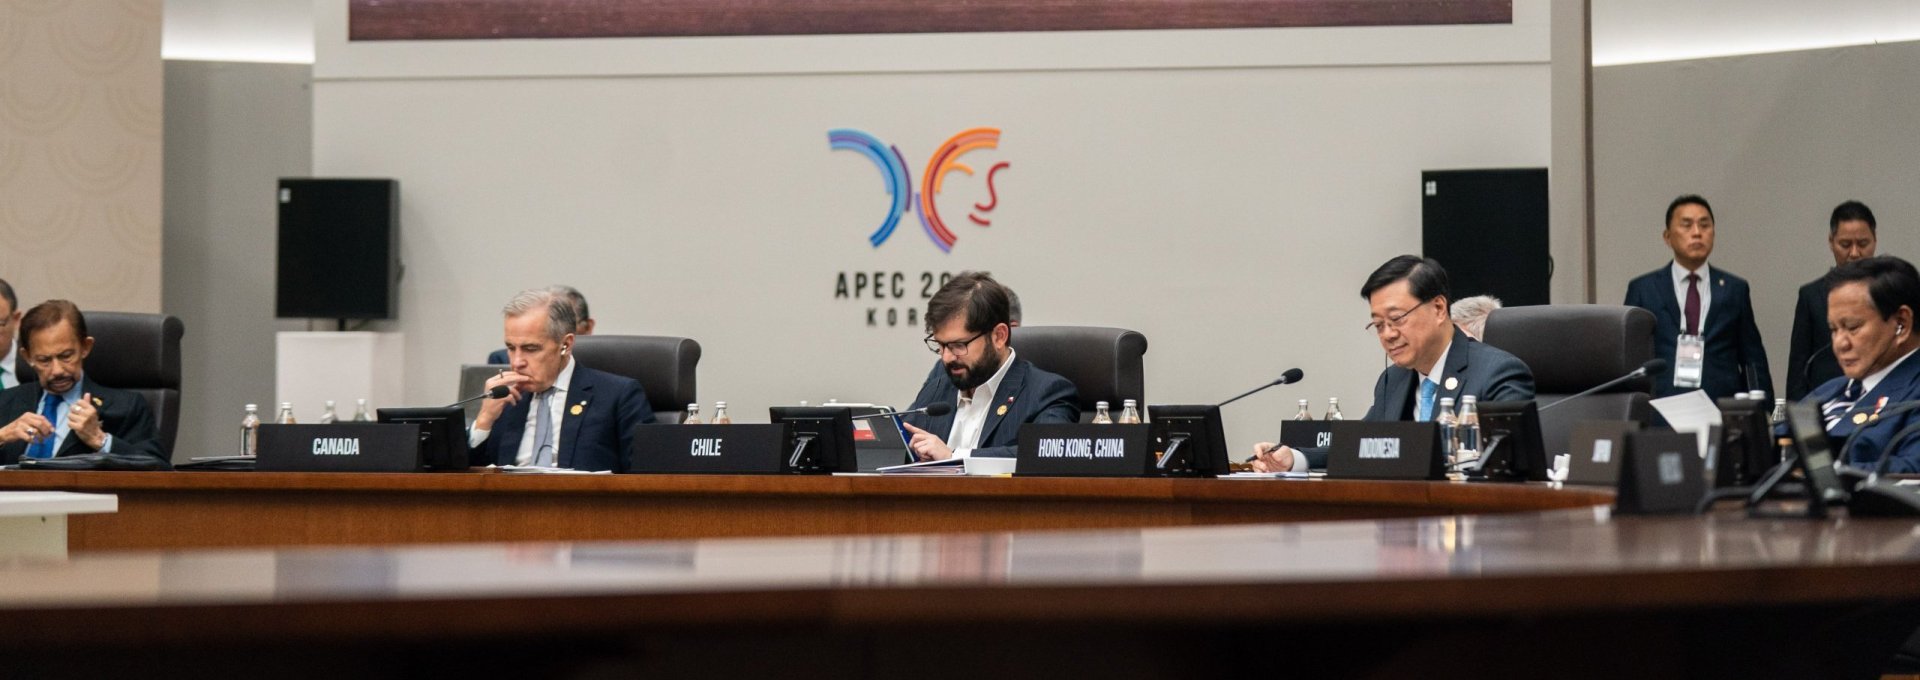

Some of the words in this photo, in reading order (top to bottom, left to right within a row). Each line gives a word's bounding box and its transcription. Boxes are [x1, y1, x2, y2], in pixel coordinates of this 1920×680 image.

[835, 272, 904, 298] APEC
[867, 308, 917, 326] KOR
[312, 437, 360, 455] CANADA
[691, 438, 722, 456] CHILE
[1316, 431, 1331, 447] CH
[1359, 437, 1400, 458] INDONESIA
[1038, 438, 1064, 457] HONG
[1065, 438, 1093, 460] KONG,
[1095, 438, 1124, 457] CHINA
